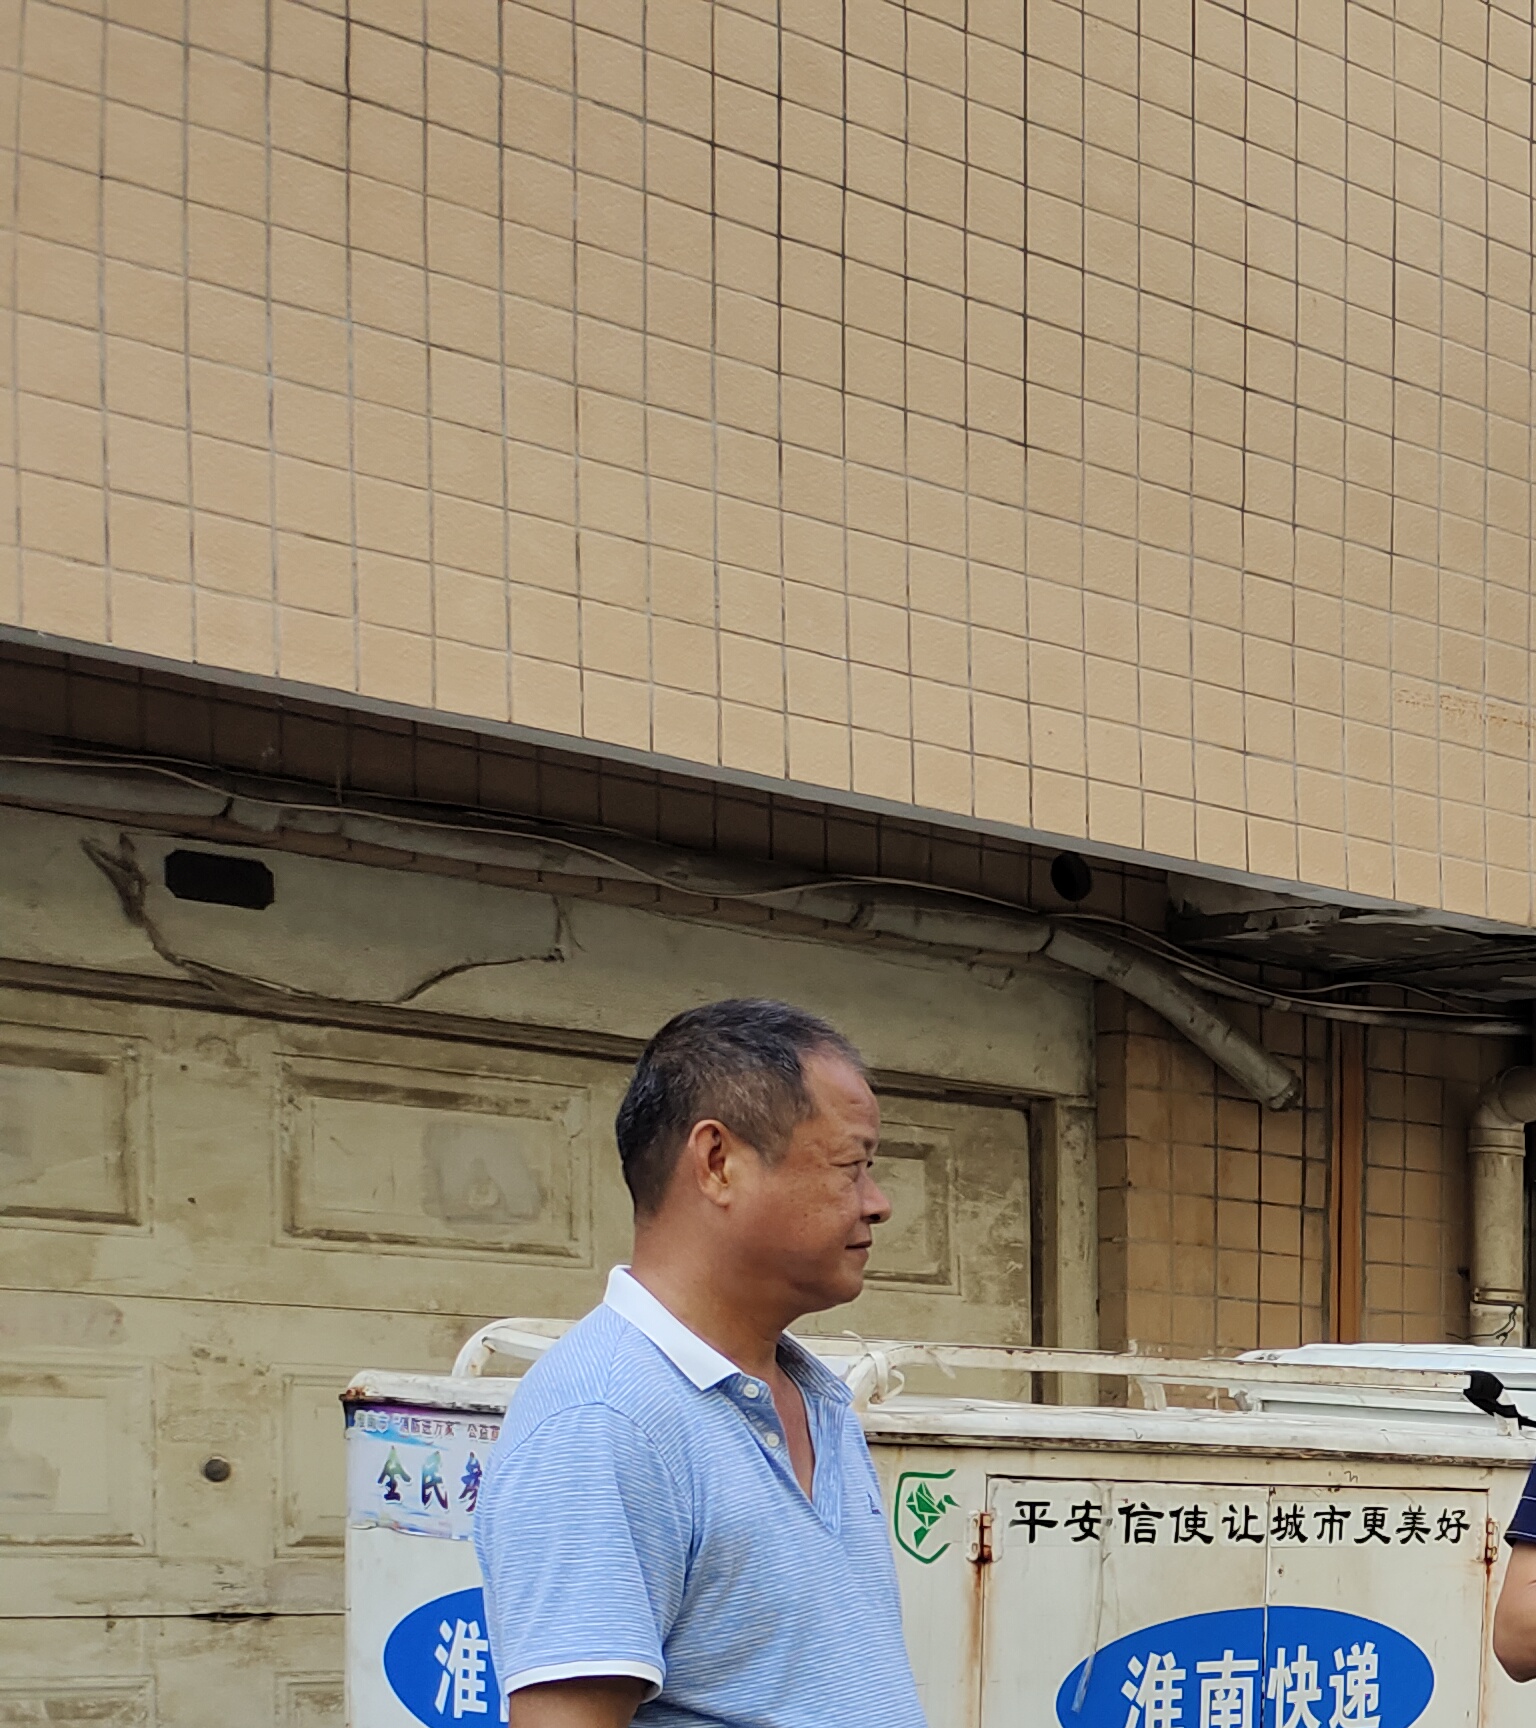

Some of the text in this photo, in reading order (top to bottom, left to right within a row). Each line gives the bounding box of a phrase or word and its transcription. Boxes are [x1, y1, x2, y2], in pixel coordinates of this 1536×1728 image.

[1008, 1499, 1471, 1545] 平安信使让城市更美好
[434, 1618, 508, 1723] 淮
